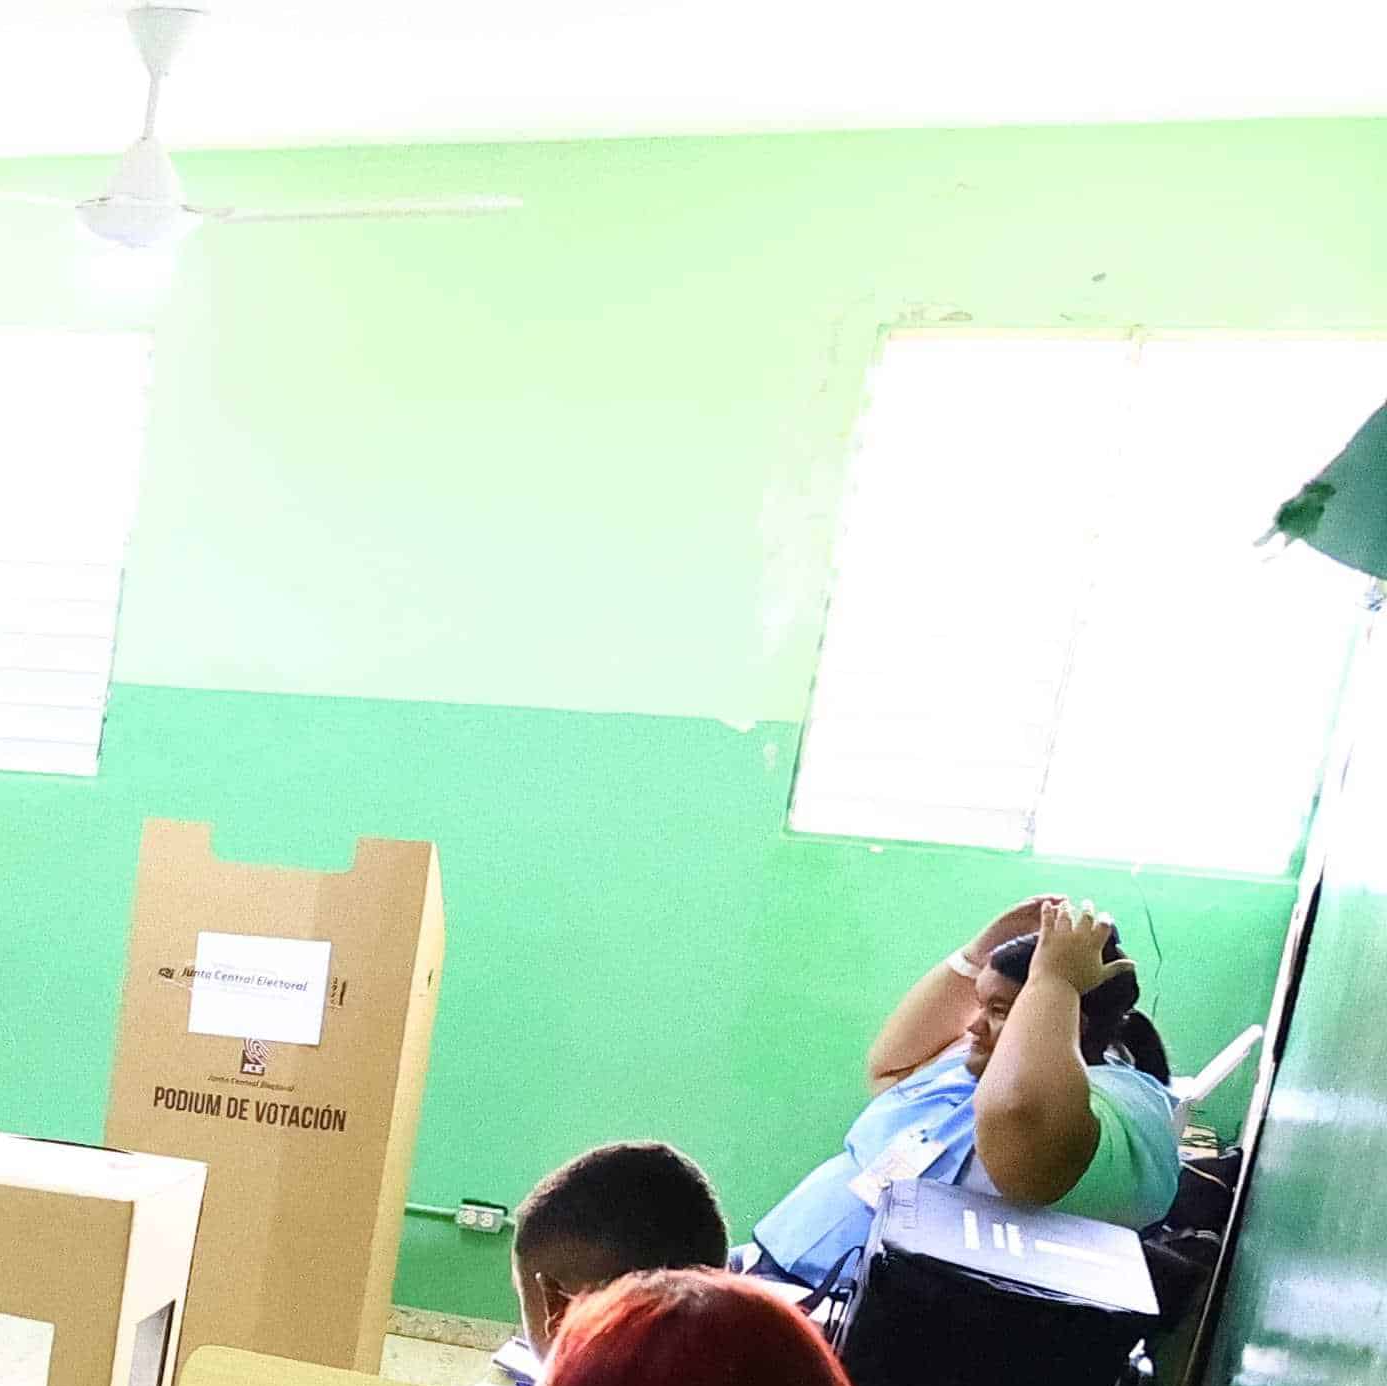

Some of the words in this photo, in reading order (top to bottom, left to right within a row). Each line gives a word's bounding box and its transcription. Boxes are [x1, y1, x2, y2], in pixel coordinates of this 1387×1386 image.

[181, 967, 212, 980] Junta
[213, 970, 255, 985] Central
[256, 976, 308, 992] Electoral
[153, 1086, 223, 1117] PODIUM
[225, 1096, 251, 1121] DE
[255, 1099, 348, 1132] VOTACIÓN
